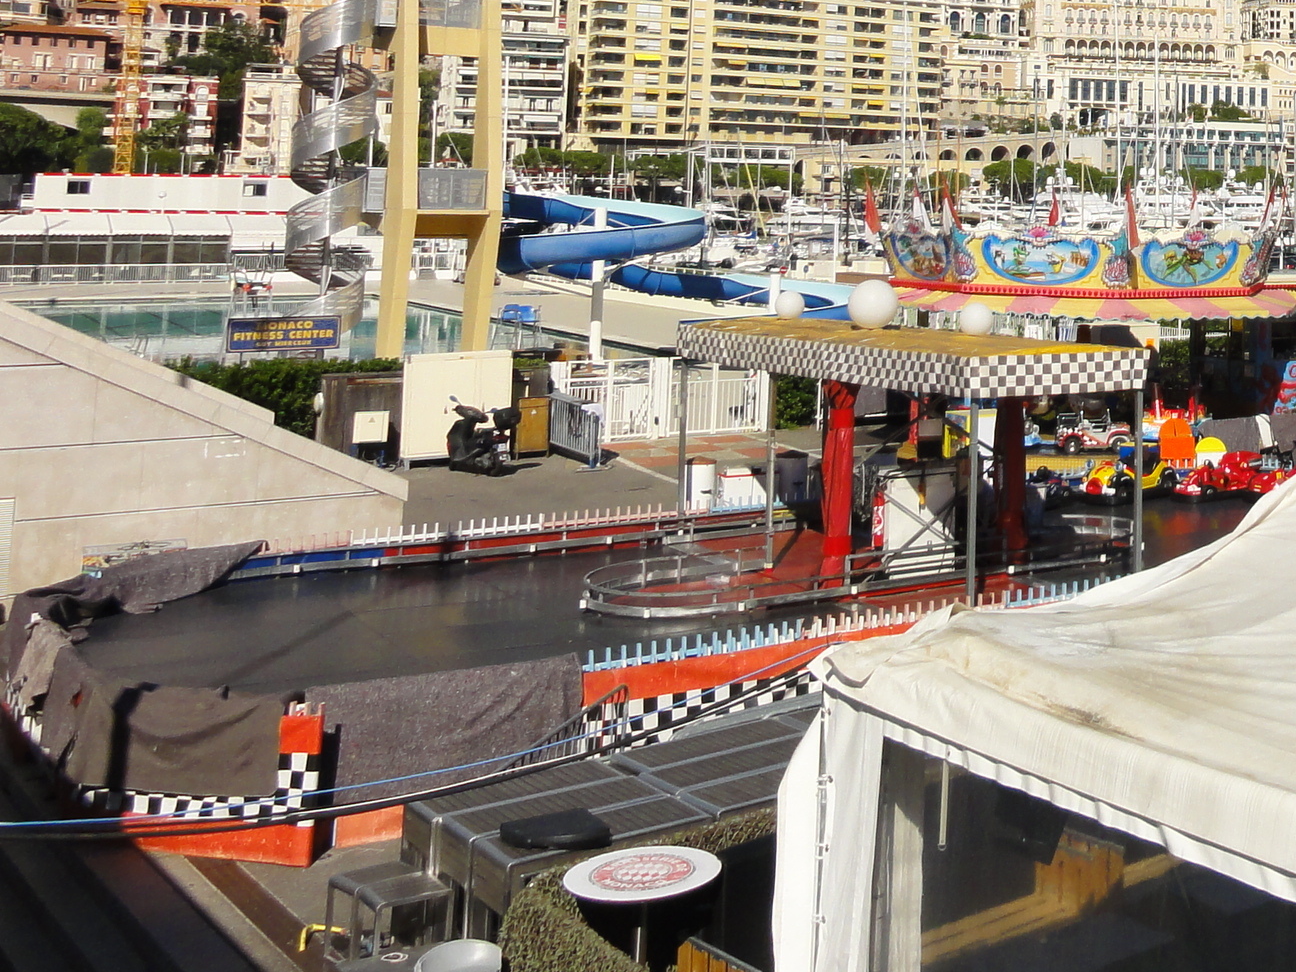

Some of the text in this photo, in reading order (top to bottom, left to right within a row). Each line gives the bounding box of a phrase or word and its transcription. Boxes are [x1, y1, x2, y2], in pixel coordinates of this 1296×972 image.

[256, 320, 314, 330] MONACO
[233, 329, 334, 341] FITNESS CENTER
[602, 878, 668, 889] MONACO
